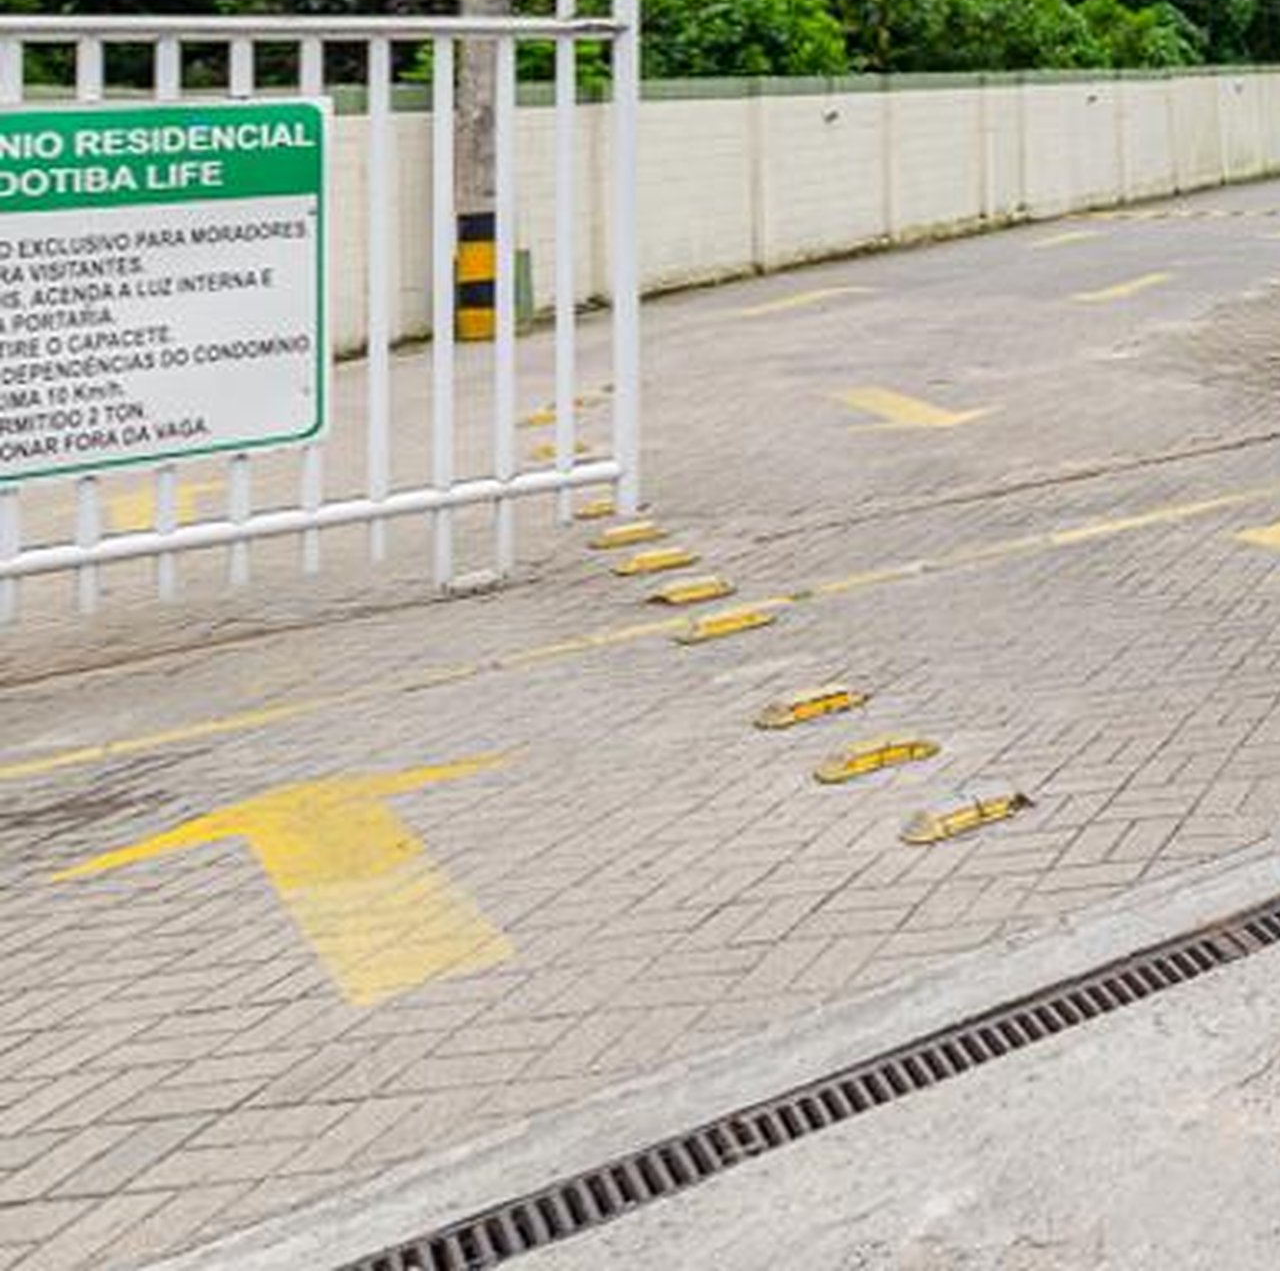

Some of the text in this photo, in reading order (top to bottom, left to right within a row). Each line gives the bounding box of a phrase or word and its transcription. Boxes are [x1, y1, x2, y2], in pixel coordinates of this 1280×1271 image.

[0, 122, 316, 160] NIO RESIDENCIAL
[147, 160, 224, 190] LIFE
[18, 233, 130, 259] EXCLUSIVO
[135, 228, 186, 247] PARA
[30, 283, 115, 308] ACENDA
[118, 282, 132, 297] A
[136, 276, 172, 297] LUZ
[176, 270, 258, 293] INTERNA
[260, 267, 275, 288] E
[46, 335, 63, 356] O
[160, 347, 190, 368] DO
[48, 386, 69, 405] 10
[89, 405, 100, 426] 2
[64, 430, 119, 452] FORA
[122, 425, 152, 447] DA
